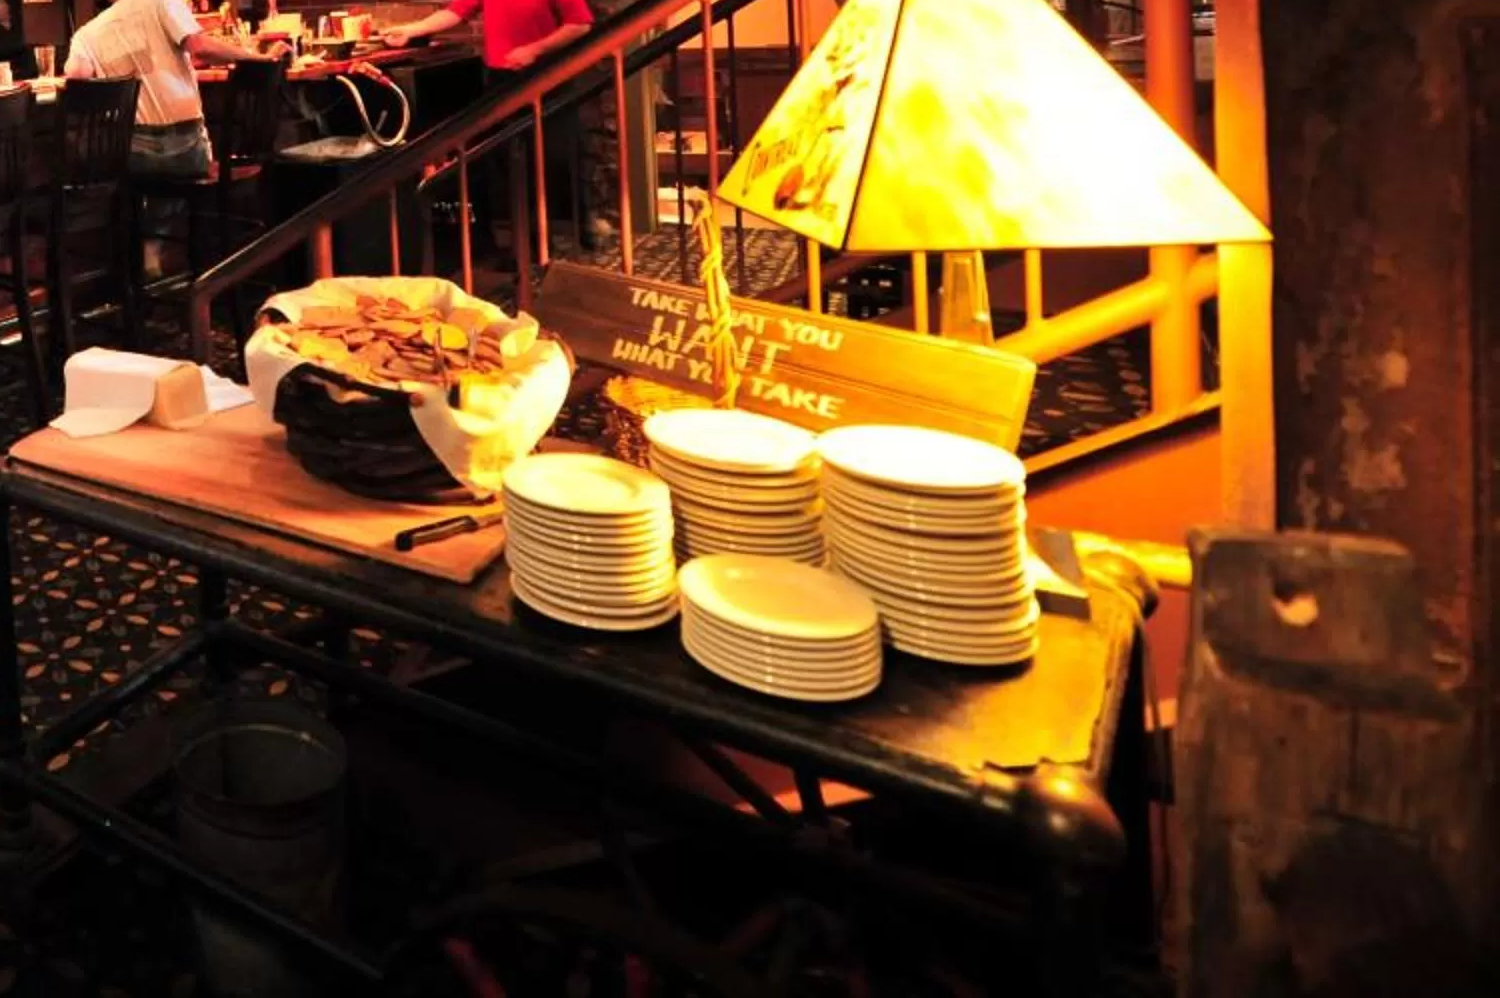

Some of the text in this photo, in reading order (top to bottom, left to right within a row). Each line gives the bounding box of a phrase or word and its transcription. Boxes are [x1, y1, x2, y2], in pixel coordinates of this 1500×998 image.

[628, 287, 693, 318] TAKE
[778, 317, 845, 351] YOU
[612, 338, 685, 371] WHAT
[751, 371, 846, 420] TAKE
